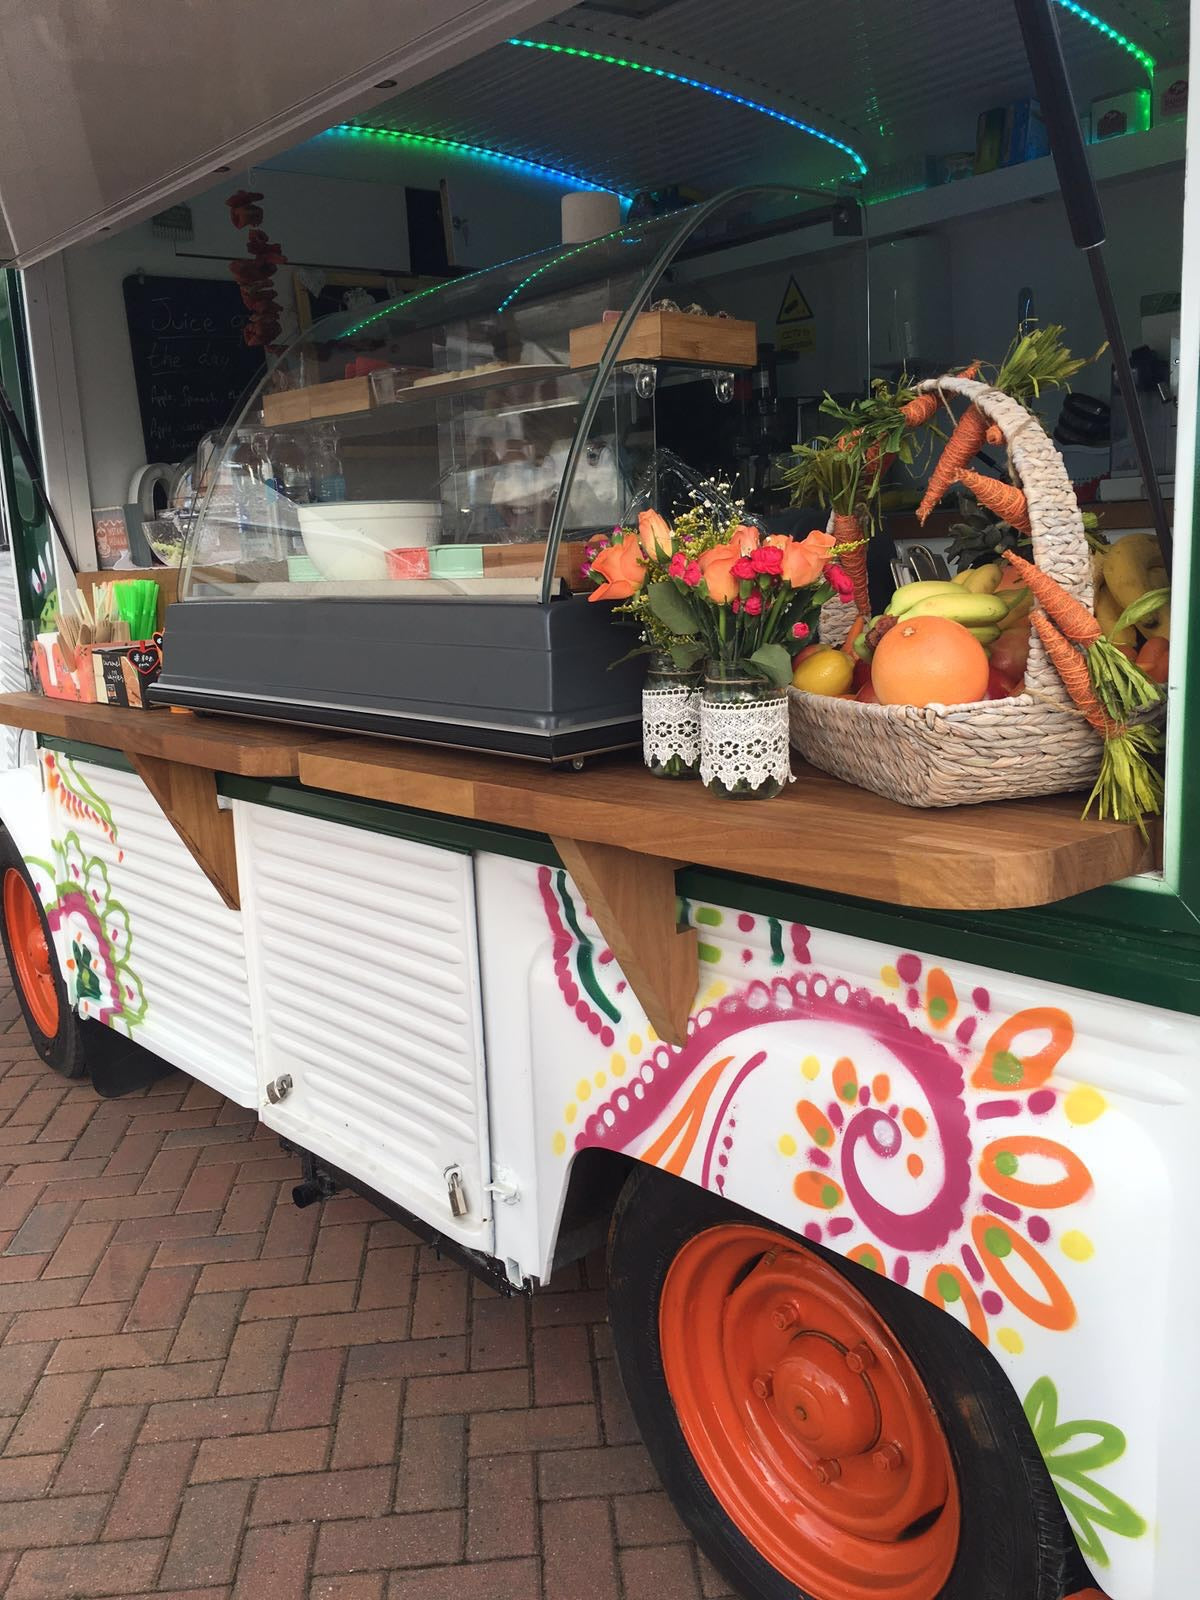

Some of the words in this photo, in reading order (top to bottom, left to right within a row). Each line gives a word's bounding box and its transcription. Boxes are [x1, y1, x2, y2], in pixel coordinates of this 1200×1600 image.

[152, 296, 216, 332] Juice
[146, 341, 181, 368] the
[199, 341, 230, 371] day
